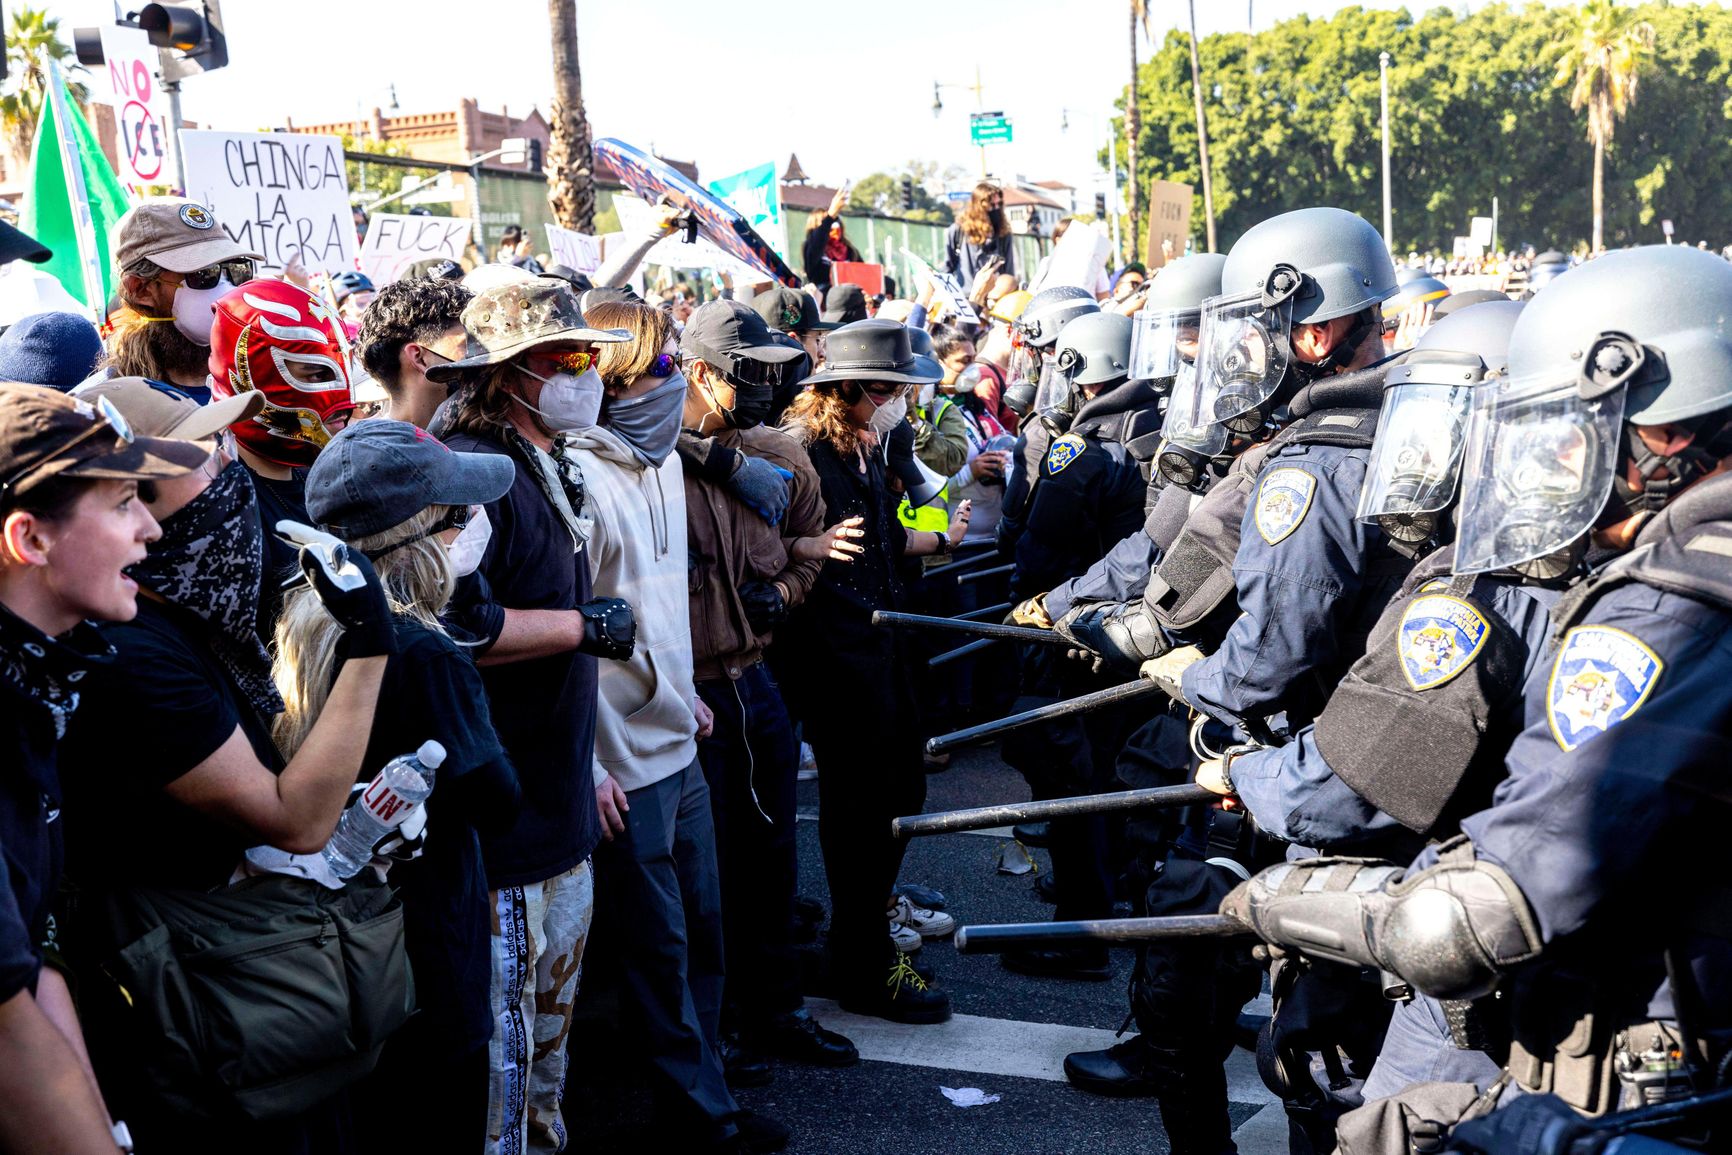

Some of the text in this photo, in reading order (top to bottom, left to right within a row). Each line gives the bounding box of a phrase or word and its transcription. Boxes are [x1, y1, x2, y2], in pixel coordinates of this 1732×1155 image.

[109, 58, 152, 103] NO
[121, 119, 164, 158] ICE
[224, 139, 344, 190] CHINGA
[255, 192, 292, 225] LA
[221, 213, 345, 275] MIGRA
[375, 218, 464, 257] FUCK
[364, 772, 413, 821] LIN'
[506, 922, 516, 959] adidas
[515, 919, 527, 956] adidas
[507, 1028, 516, 1063] adidas
[506, 1081, 518, 1117] adidas
